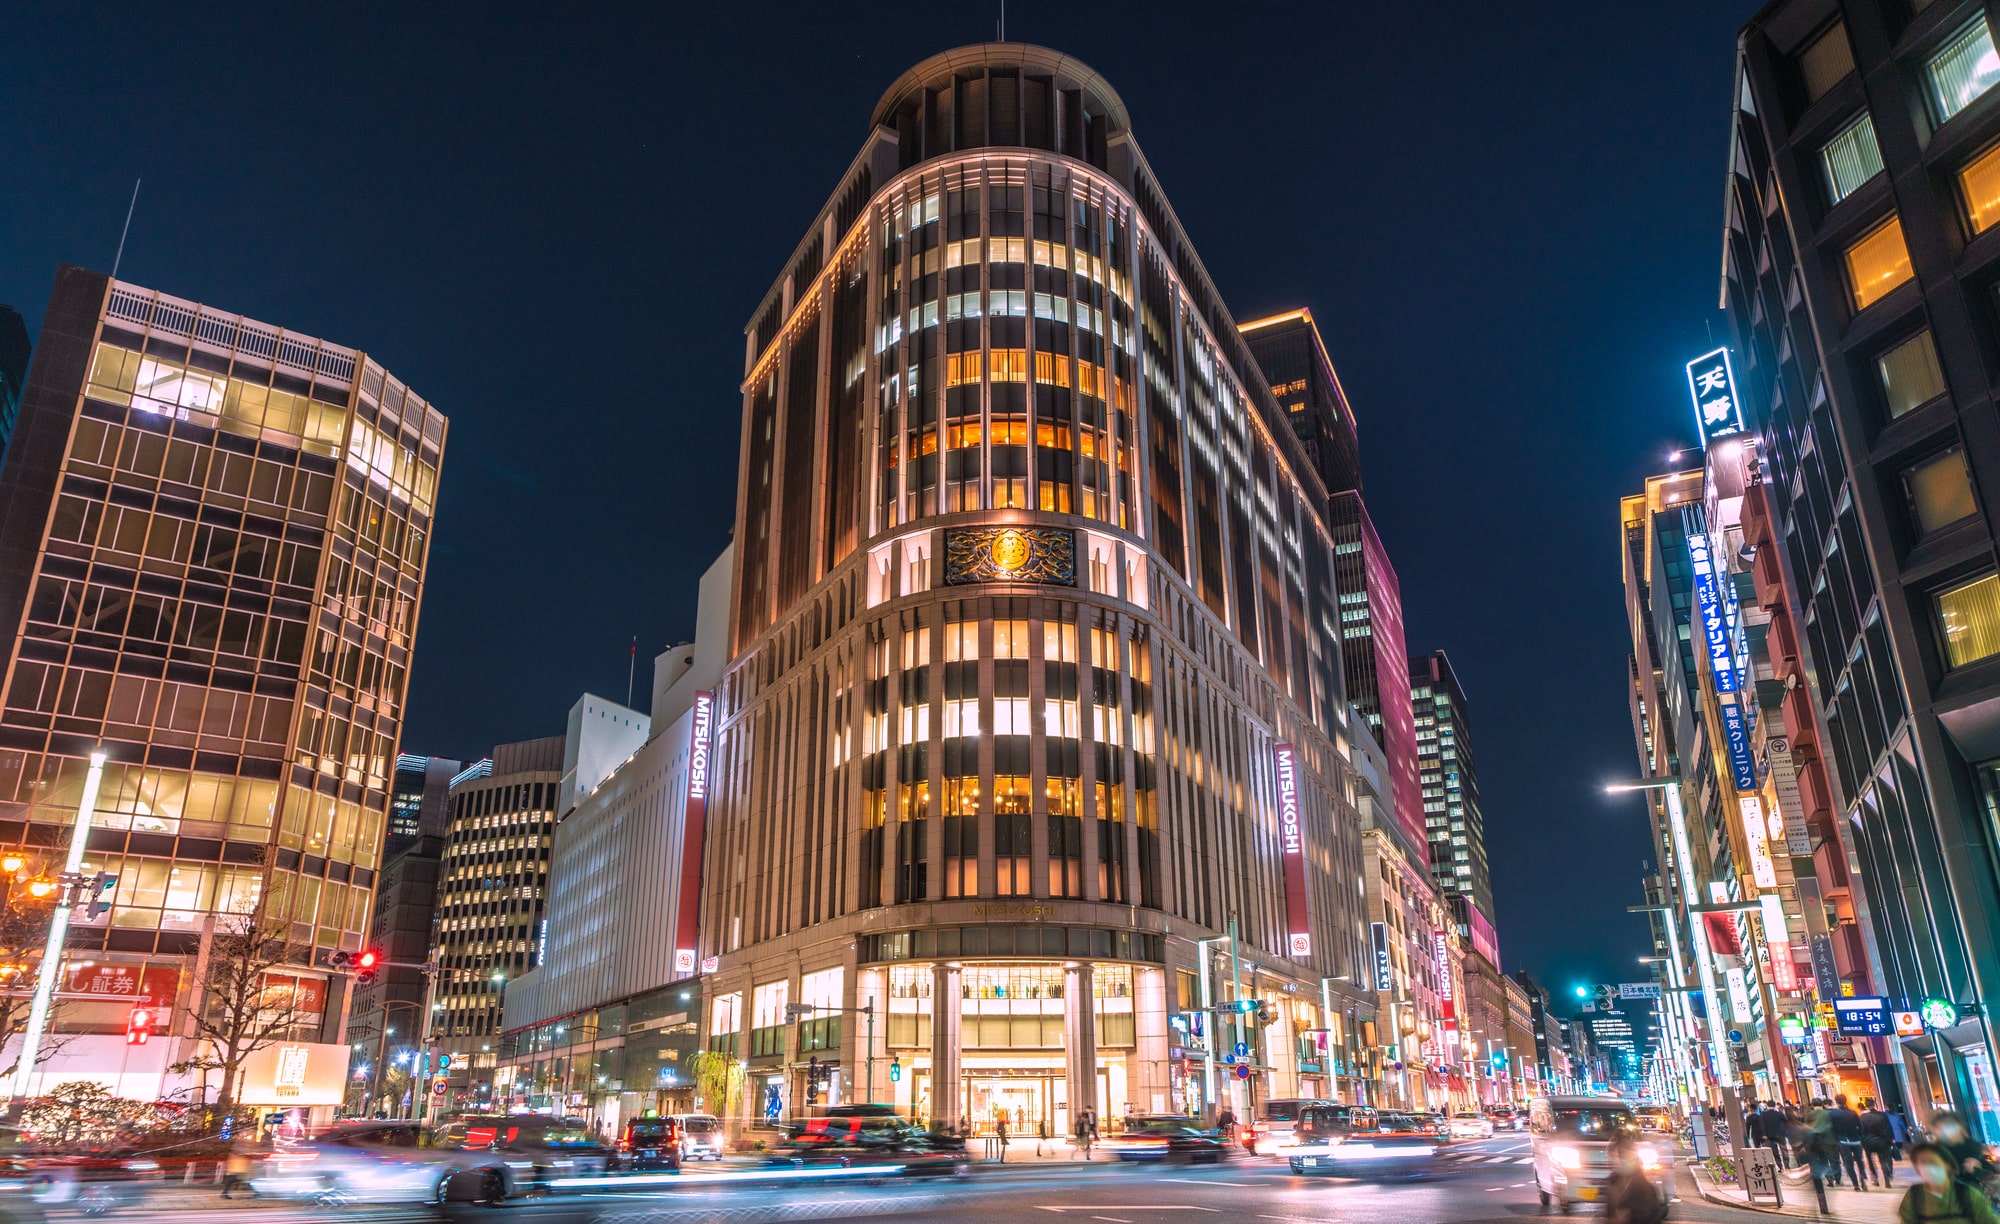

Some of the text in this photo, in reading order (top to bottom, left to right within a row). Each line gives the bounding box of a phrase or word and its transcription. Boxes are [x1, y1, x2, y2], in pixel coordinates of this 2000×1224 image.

[1696, 366, 1737, 437] 天野
[691, 697, 710, 799] MITSUKOSHI
[1725, 707, 1751, 787] 恵友クリニック
[1279, 750, 1300, 854] MITSUKOSHI
[973, 905, 1056, 916] MITSUKOSHI
[1436, 935, 1452, 1000] MITSUKOSHI
[1623, 986, 1660, 994] 日本橋北詰
[1846, 1012, 1881, 1021] 18:54
[1751, 1163, 1767, 1192] 宮川
